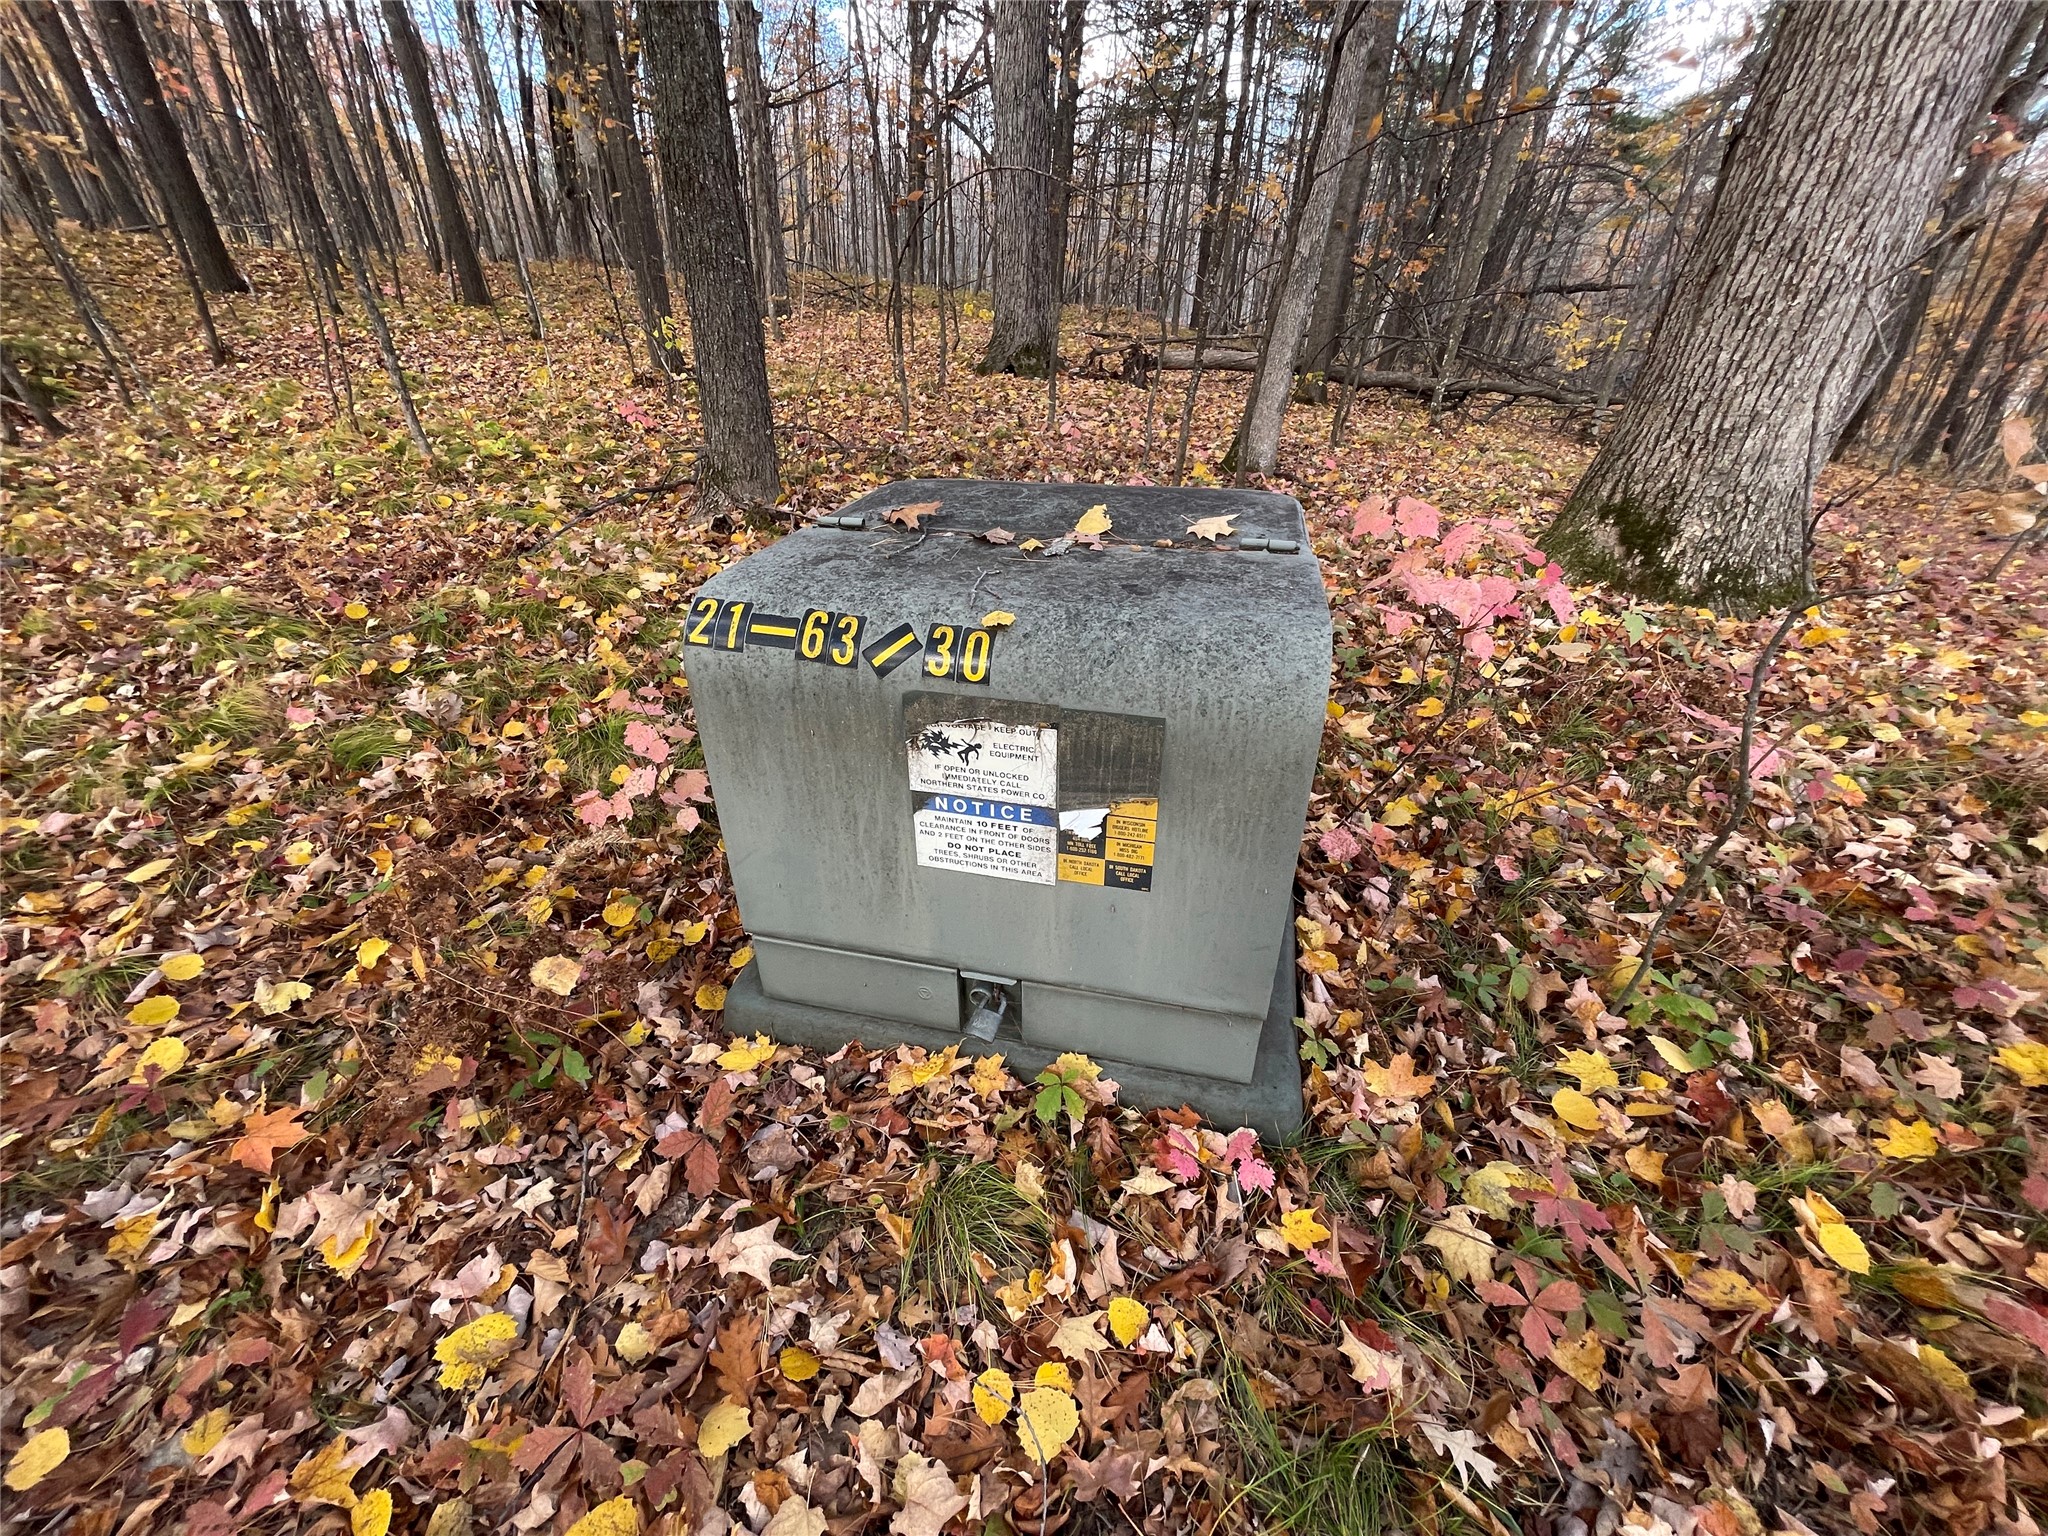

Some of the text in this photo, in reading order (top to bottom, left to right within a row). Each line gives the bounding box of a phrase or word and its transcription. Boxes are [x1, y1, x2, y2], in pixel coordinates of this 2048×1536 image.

[994, 726, 1016, 734] KEEP
[989, 750, 1039, 762] EQUIPMENT
[993, 742, 1035, 754] ELECTRIC
[942, 773, 1021, 789] IMMEDIATELY CALL
[943, 765, 966, 774] OPEN
[983, 769, 1029, 782] UNLOCKED
[920, 778, 964, 790] NORTHERN
[966, 784, 999, 794] STATES
[1001, 788, 1031, 798] POWER
[935, 796, 1033, 822] NOTICE
[934, 815, 973, 826] MAINTAIN
[990, 822, 1018, 832] FEET
[919, 821, 966, 833] CLEARANCE
[979, 829, 1005, 839] FRONT
[1021, 835, 1051, 845] DOORS
[919, 829, 936, 837] AND
[945, 832, 963, 841] FEET
[966, 835, 978, 843] ON
[980, 837, 996, 846] THE
[998, 840, 1026, 850] OTHER
[1027, 844, 1052, 853] SIDES
[947, 842, 1022, 858] DO NOT PLACE
[928, 855, 988, 870] OBSTRUCTIONS
[1001, 866, 1019, 874] THIS
[1021, 869, 1043, 878] AREA
[962, 853, 994, 863] SHRUBS
[1010, 859, 1037, 869] OTHER
